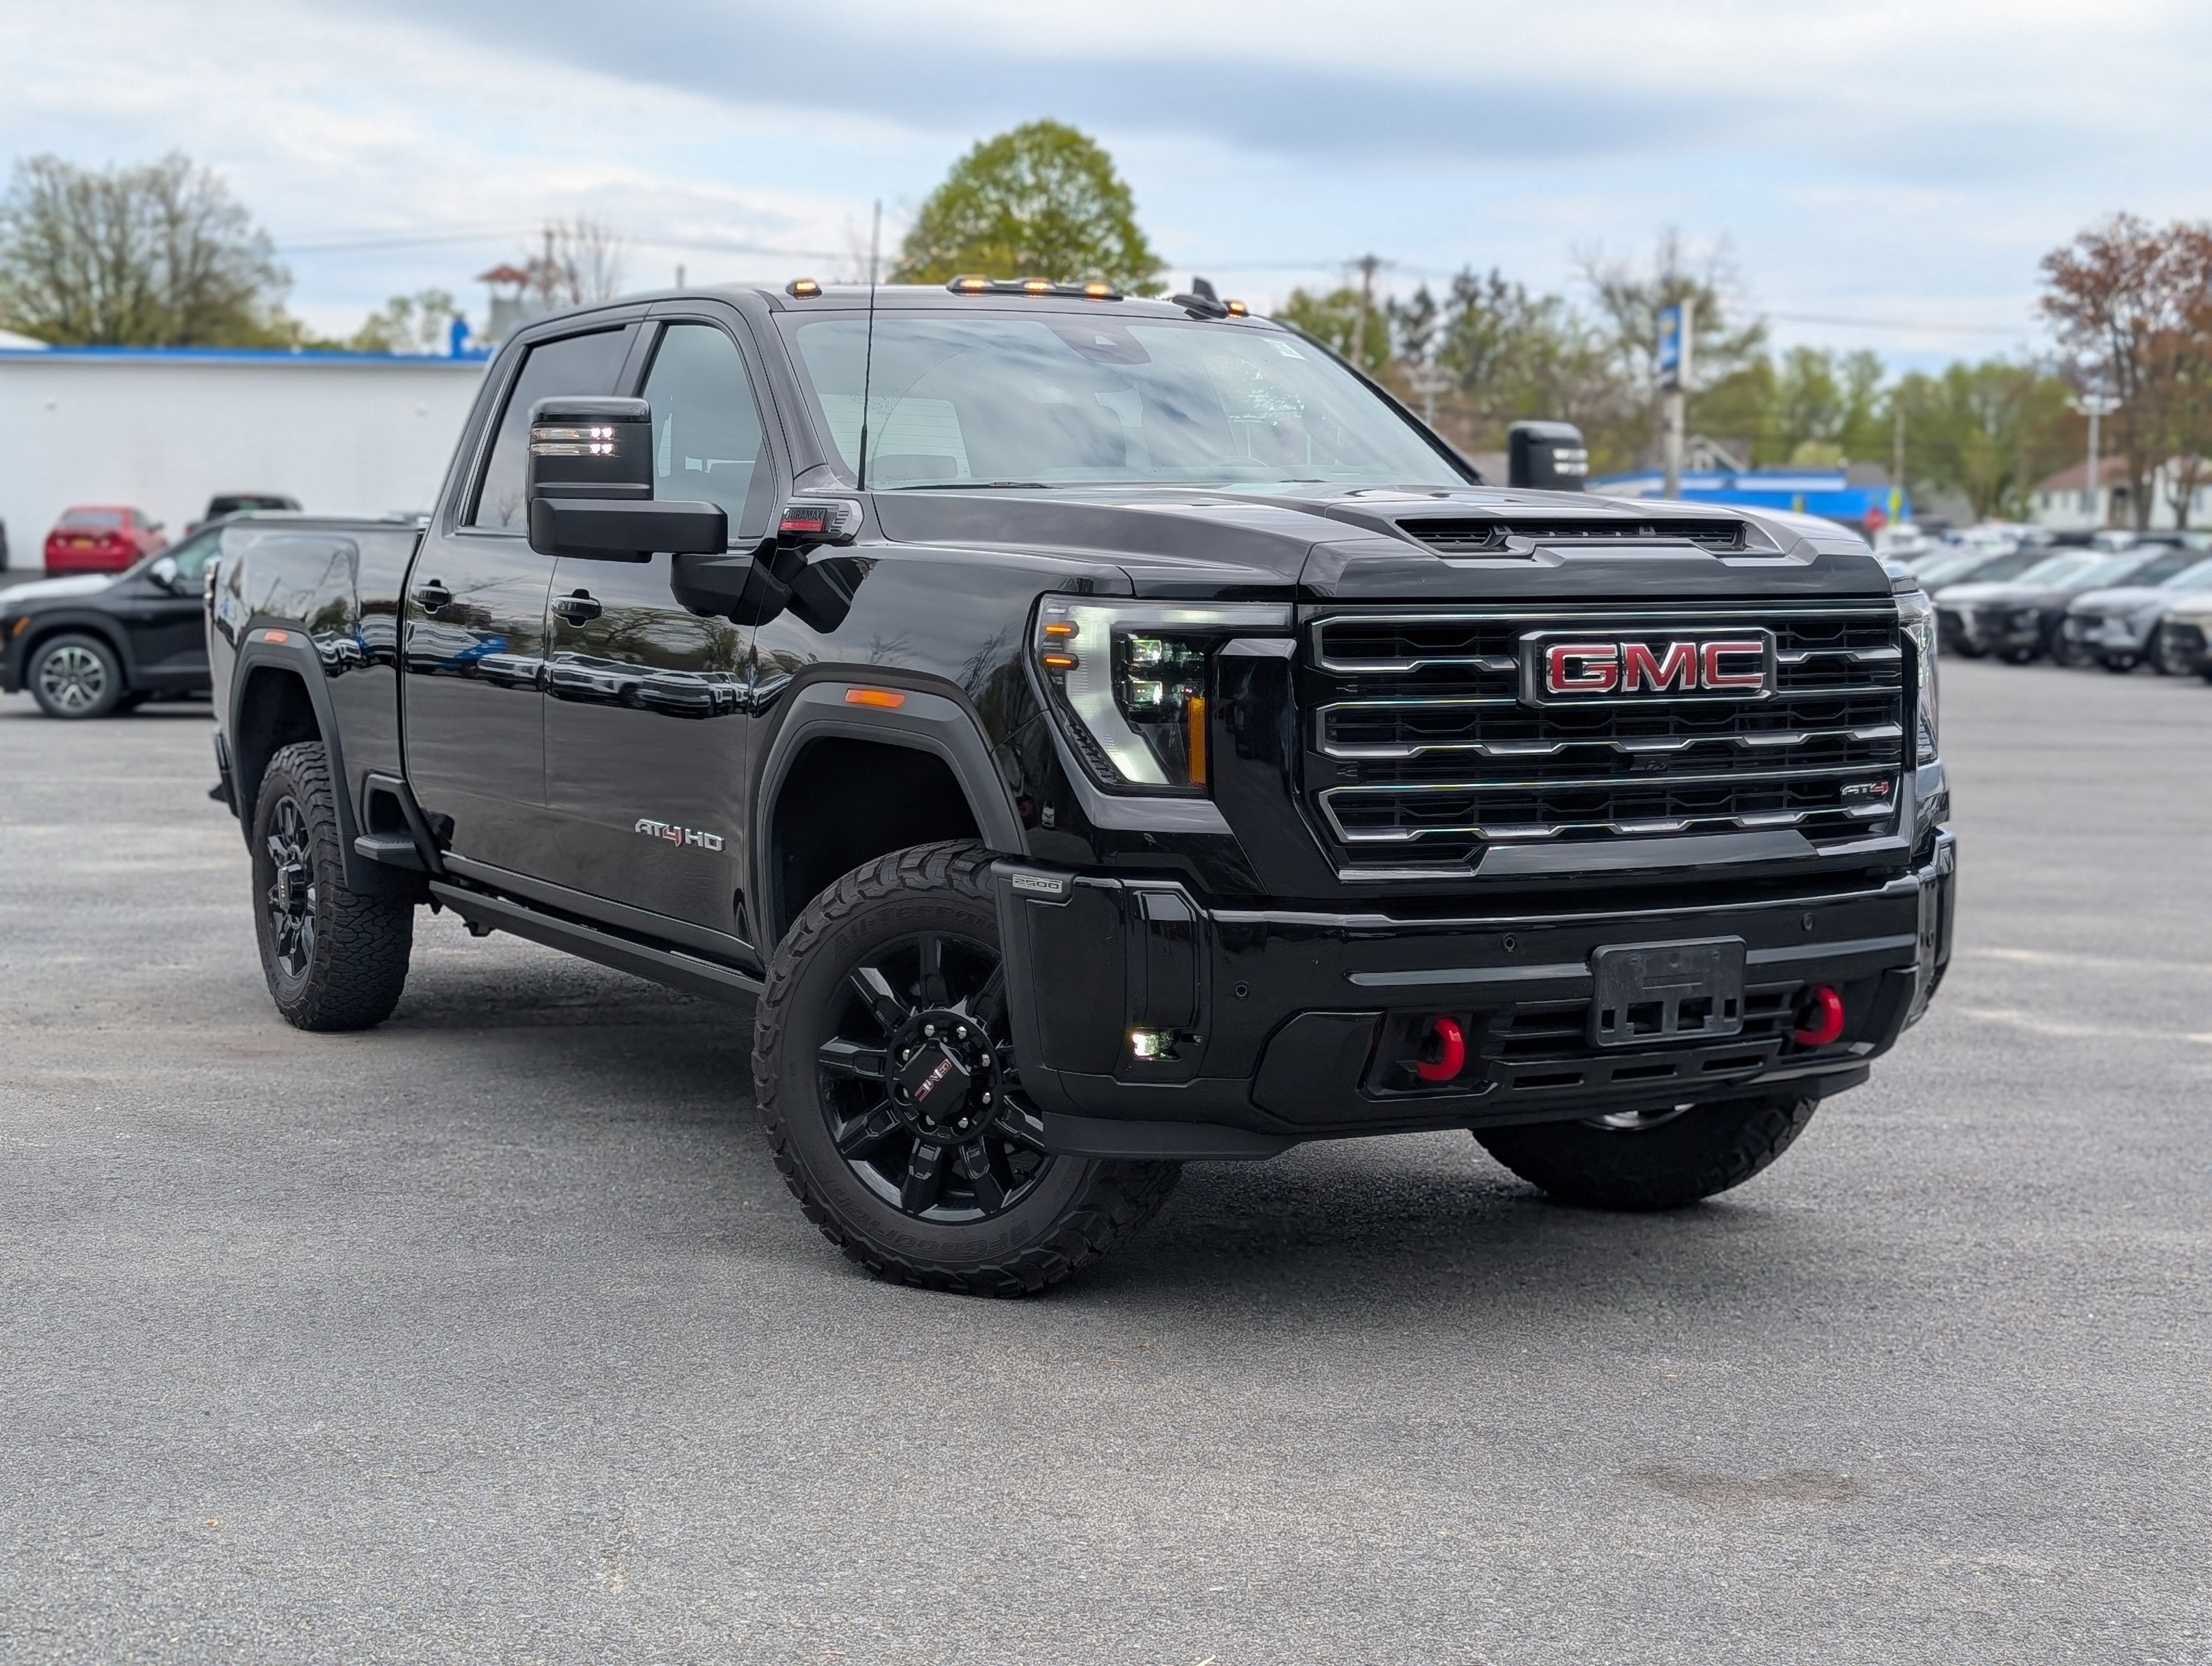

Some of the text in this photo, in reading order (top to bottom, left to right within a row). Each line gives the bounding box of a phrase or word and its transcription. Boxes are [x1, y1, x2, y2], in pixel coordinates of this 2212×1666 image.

[782, 508, 824, 521] DURAMAX
[1546, 641, 1766, 694] GMC
[1841, 781, 1889, 796] AT4
[1014, 877, 1059, 889] 2500
[914, 1058, 952, 1102] GMC
